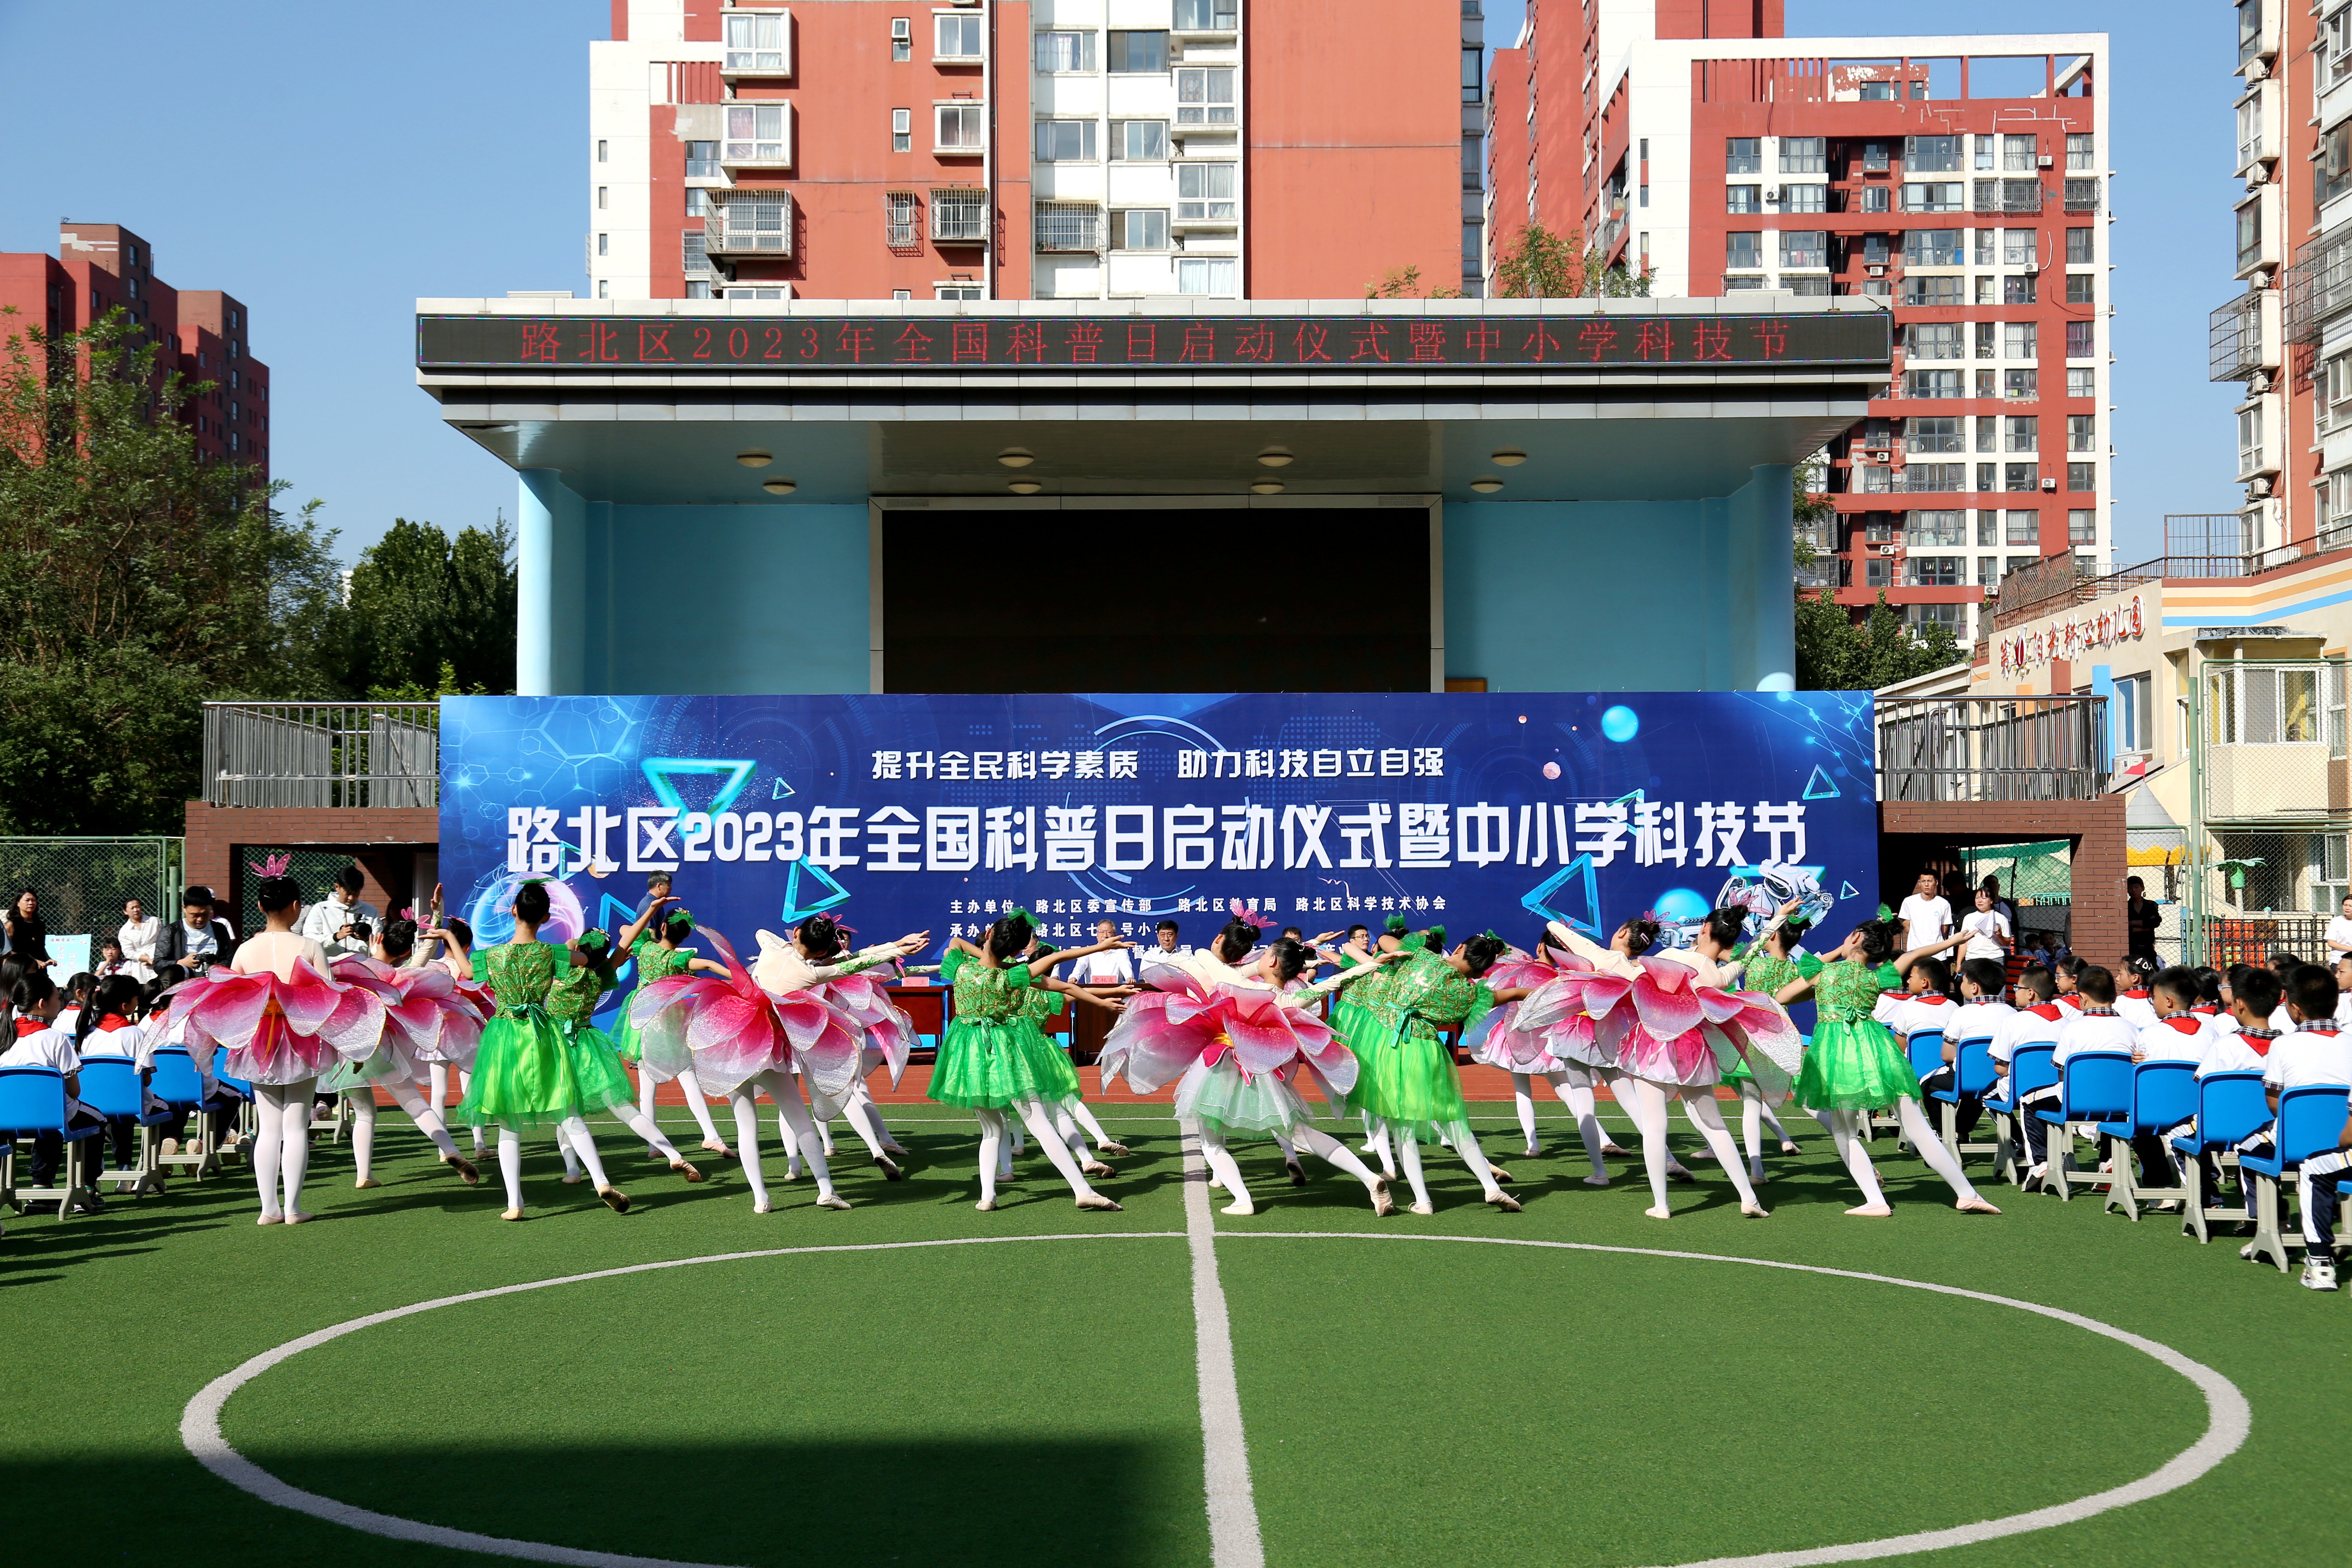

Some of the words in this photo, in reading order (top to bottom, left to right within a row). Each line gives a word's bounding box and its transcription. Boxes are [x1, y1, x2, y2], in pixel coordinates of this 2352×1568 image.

[521, 320, 1789, 361] 路北区2023年全国科普日启动仪式暨中小学科技节
[871, 750, 1138, 780] 提升全民科学素质
[1177, 747, 1444, 778] 助力科技自立自强
[507, 801, 1806, 872] 路北区2023年全国科普日启动仪式暨中小学科技节
[1035, 898, 1152, 914] 路北区委宣传部
[1295, 895, 1446, 911] 路北区科学技术协会
[1036, 922, 1159, 937] 路北区七号小
